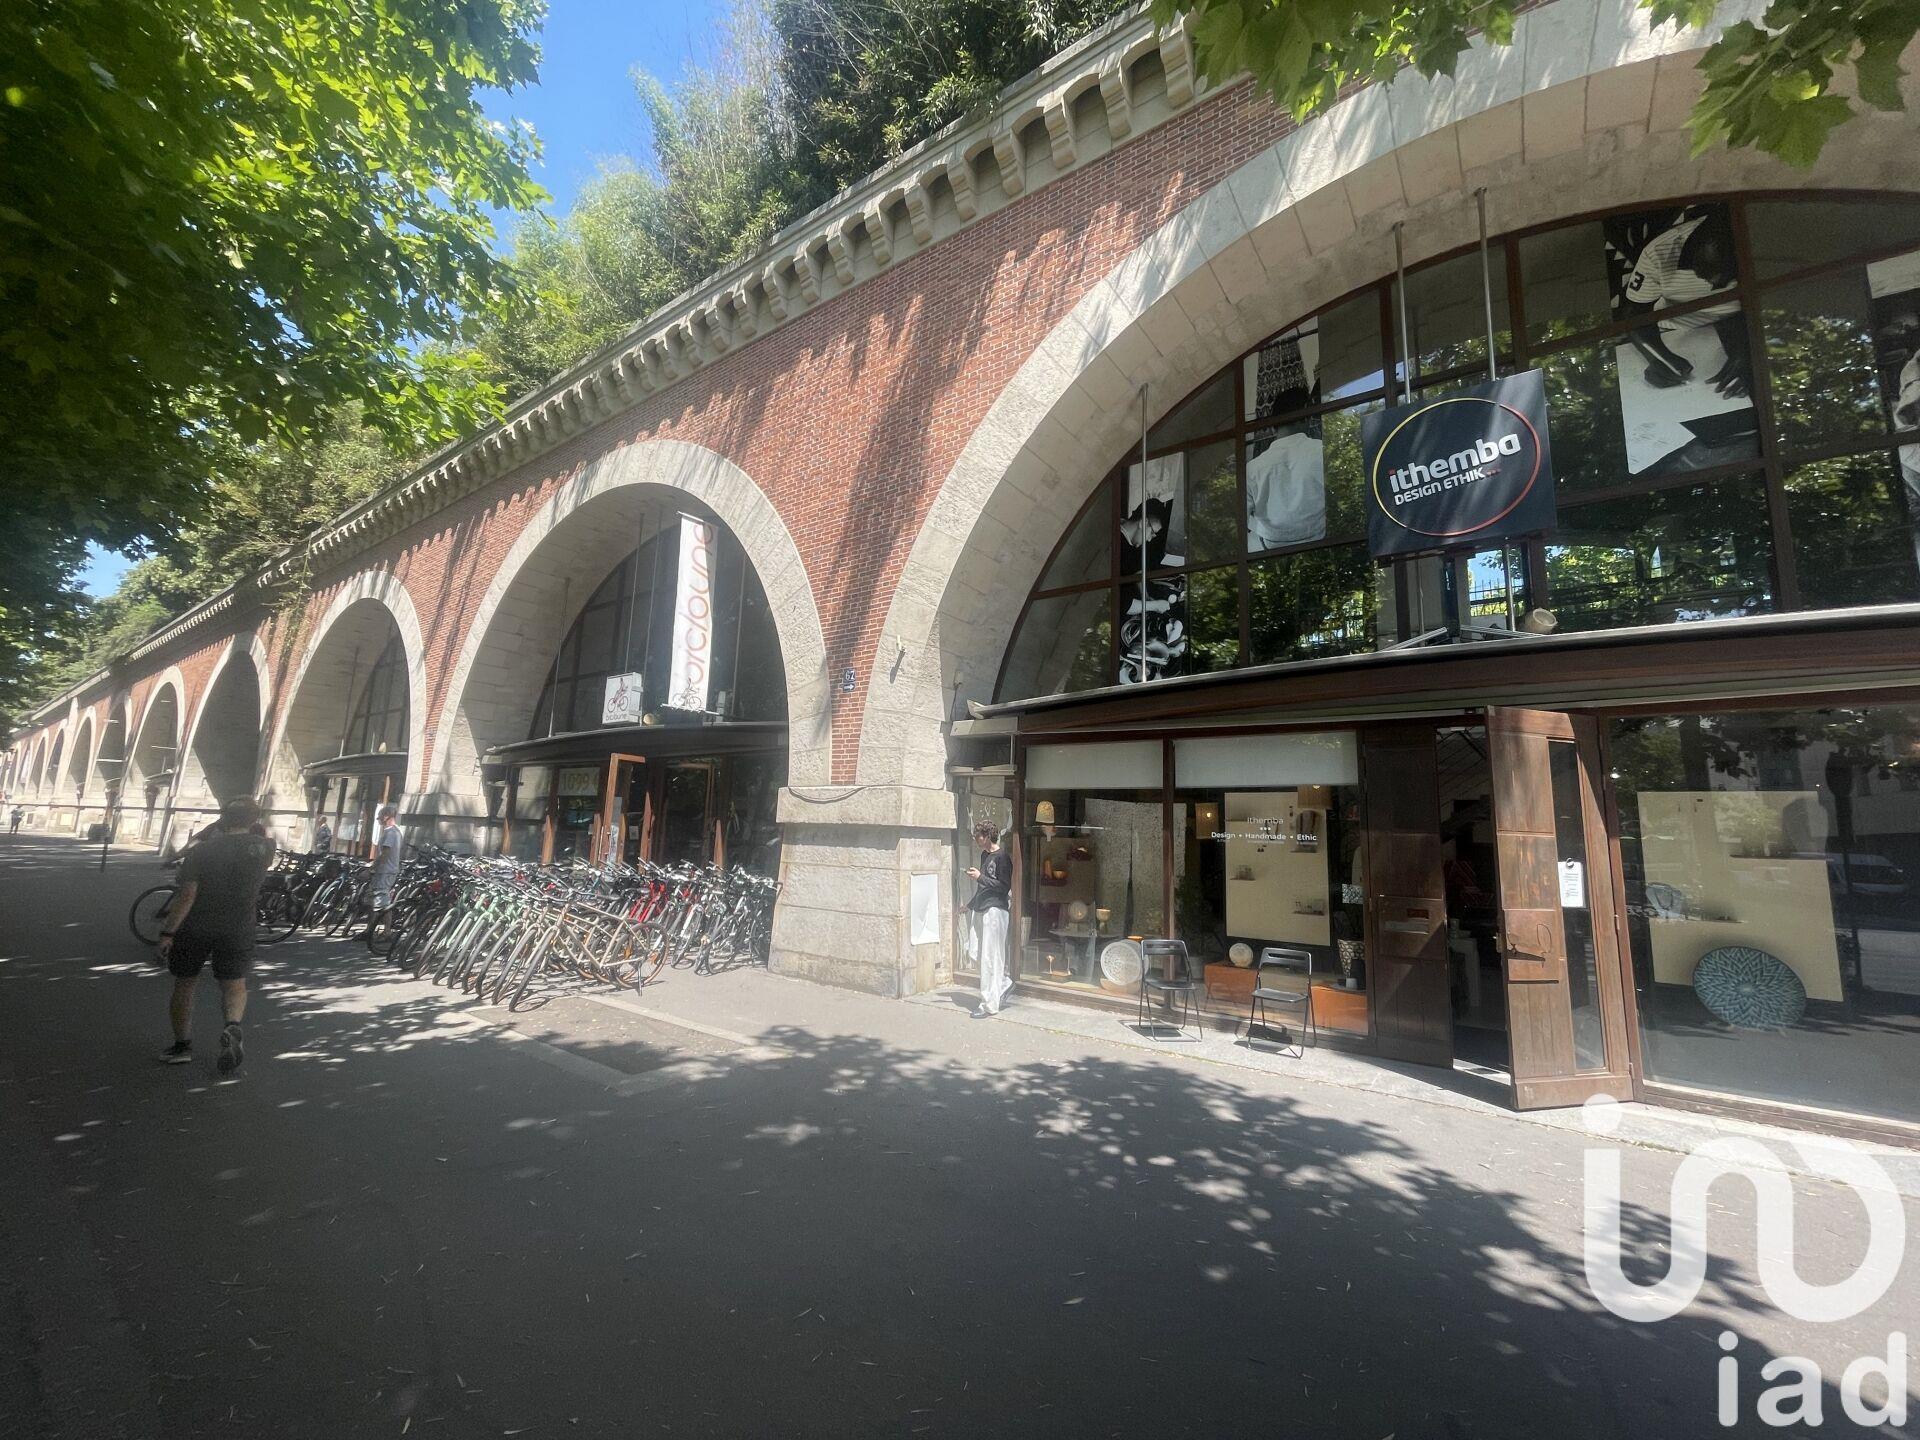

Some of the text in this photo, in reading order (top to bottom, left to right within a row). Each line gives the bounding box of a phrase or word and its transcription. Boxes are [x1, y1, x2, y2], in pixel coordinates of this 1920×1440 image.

[1629, 271, 1645, 292] 3
[1388, 433, 1521, 493] ithemba
[1394, 466, 1486, 506] DESIGN ETHIK
[1211, 831, 1317, 841] Design Handmade Ethic
